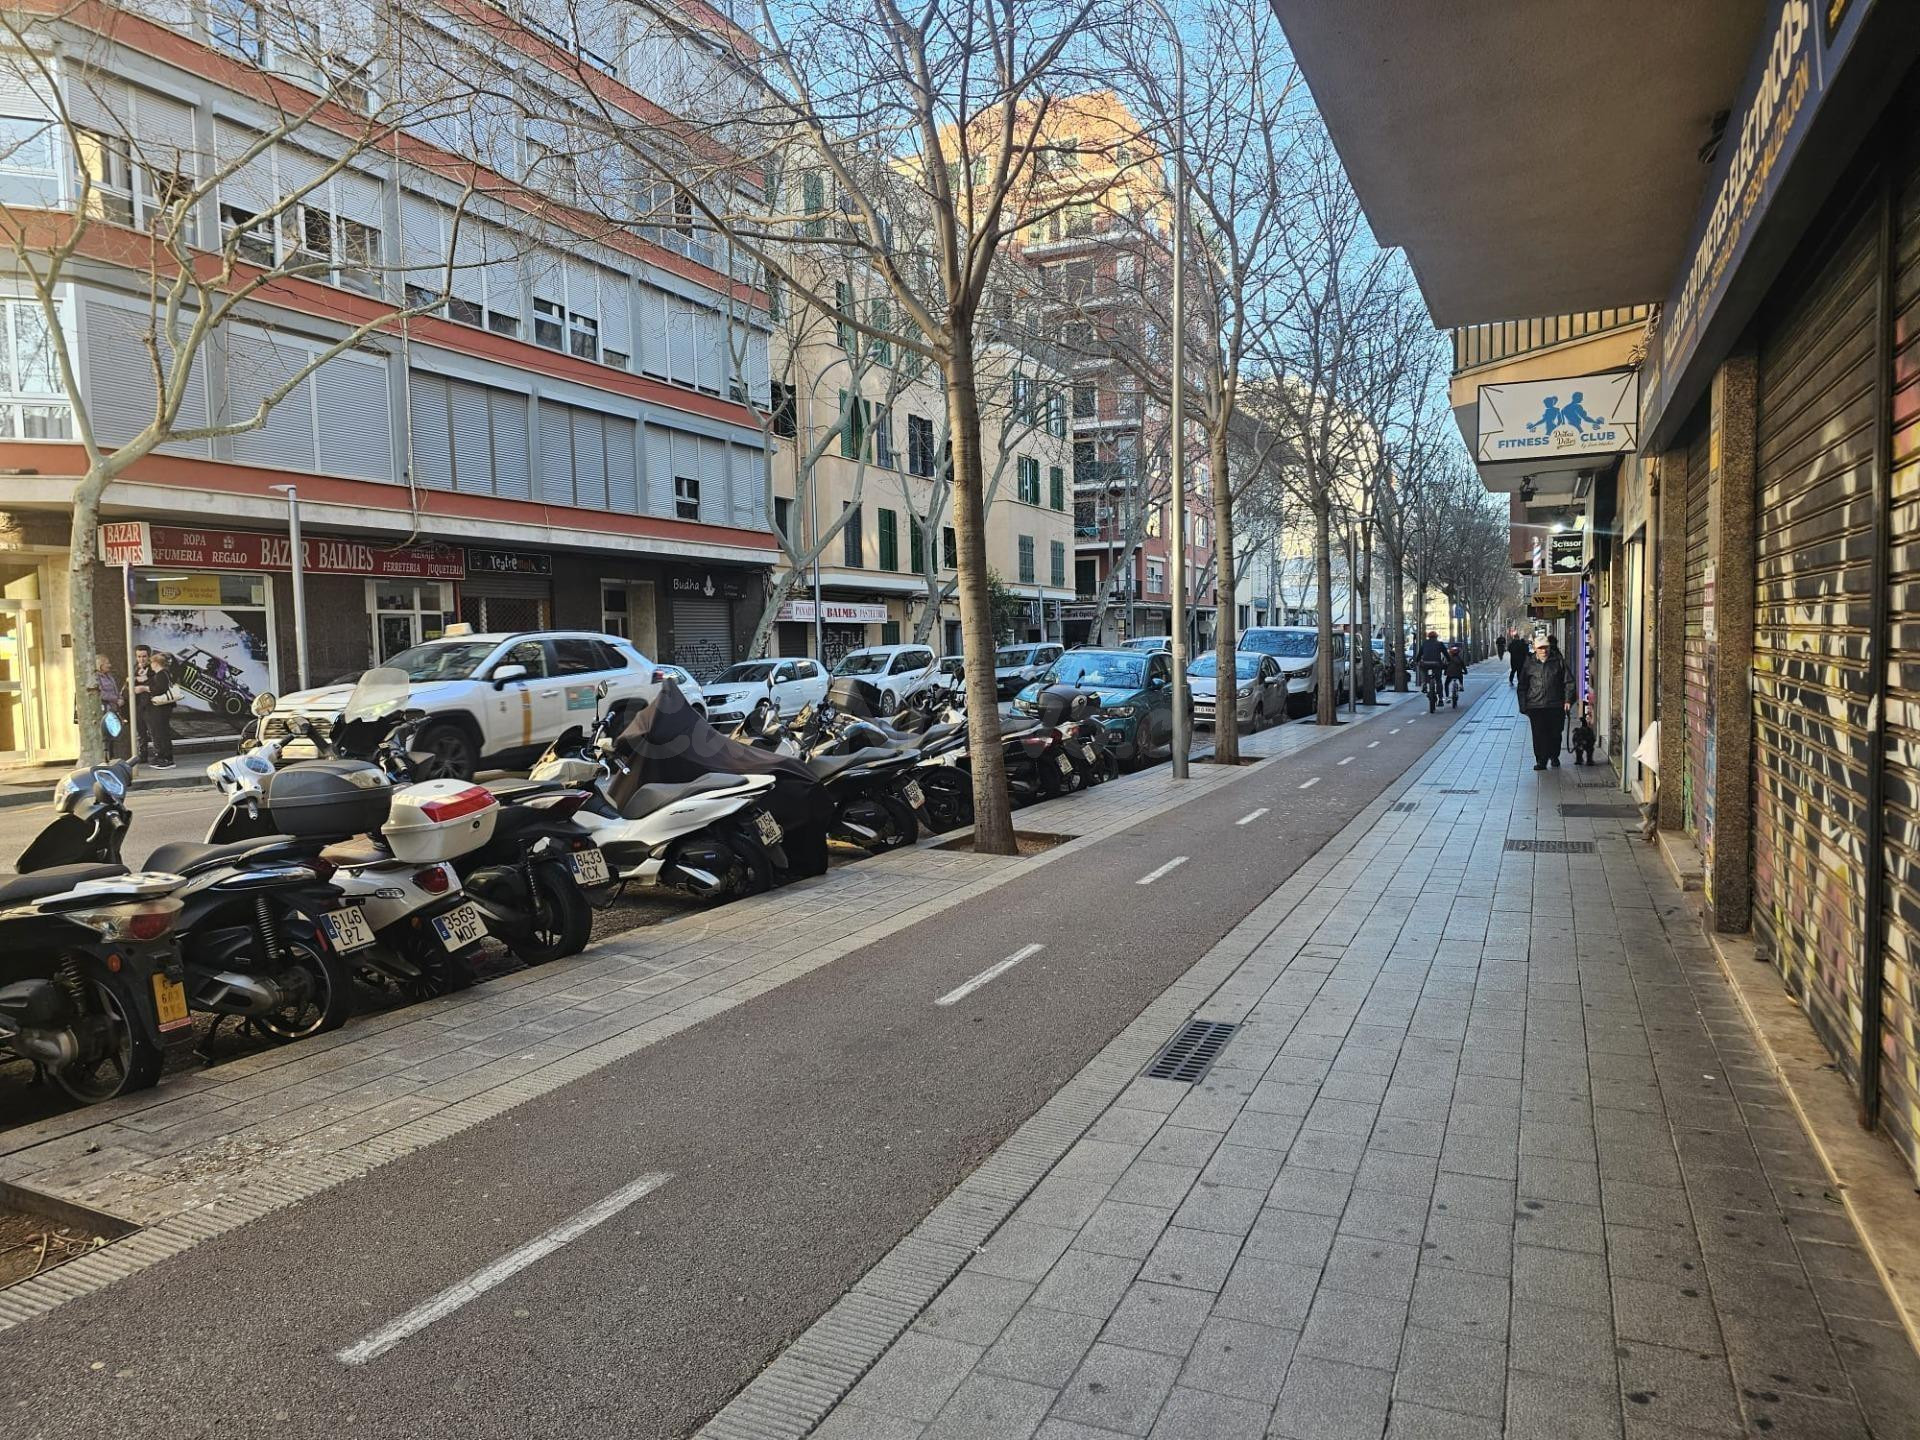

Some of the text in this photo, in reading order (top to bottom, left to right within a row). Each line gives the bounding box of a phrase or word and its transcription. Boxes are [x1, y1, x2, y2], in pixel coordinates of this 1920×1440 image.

[1498, 437, 1549, 448] FITNESS
[1580, 431, 1615, 441] CLUB
[106, 525, 140, 543] BAZAR
[183, 534, 206, 545] ROPA
[106, 547, 143, 564] BALMES
[212, 551, 247, 563] REGALO
[261, 538, 374, 570] BAZR BALMES
[383, 561, 420, 573] FERRETERIA
[673, 578, 699, 591] Budha
[827, 608, 857, 618] BALMES
[576, 851, 602, 866] 8433
[582, 864, 601, 880] KCX
[331, 909, 362, 930] 6146
[443, 906, 476, 930] 3569
[337, 927, 364, 946] LPZ
[454, 922, 479, 943] MDF
